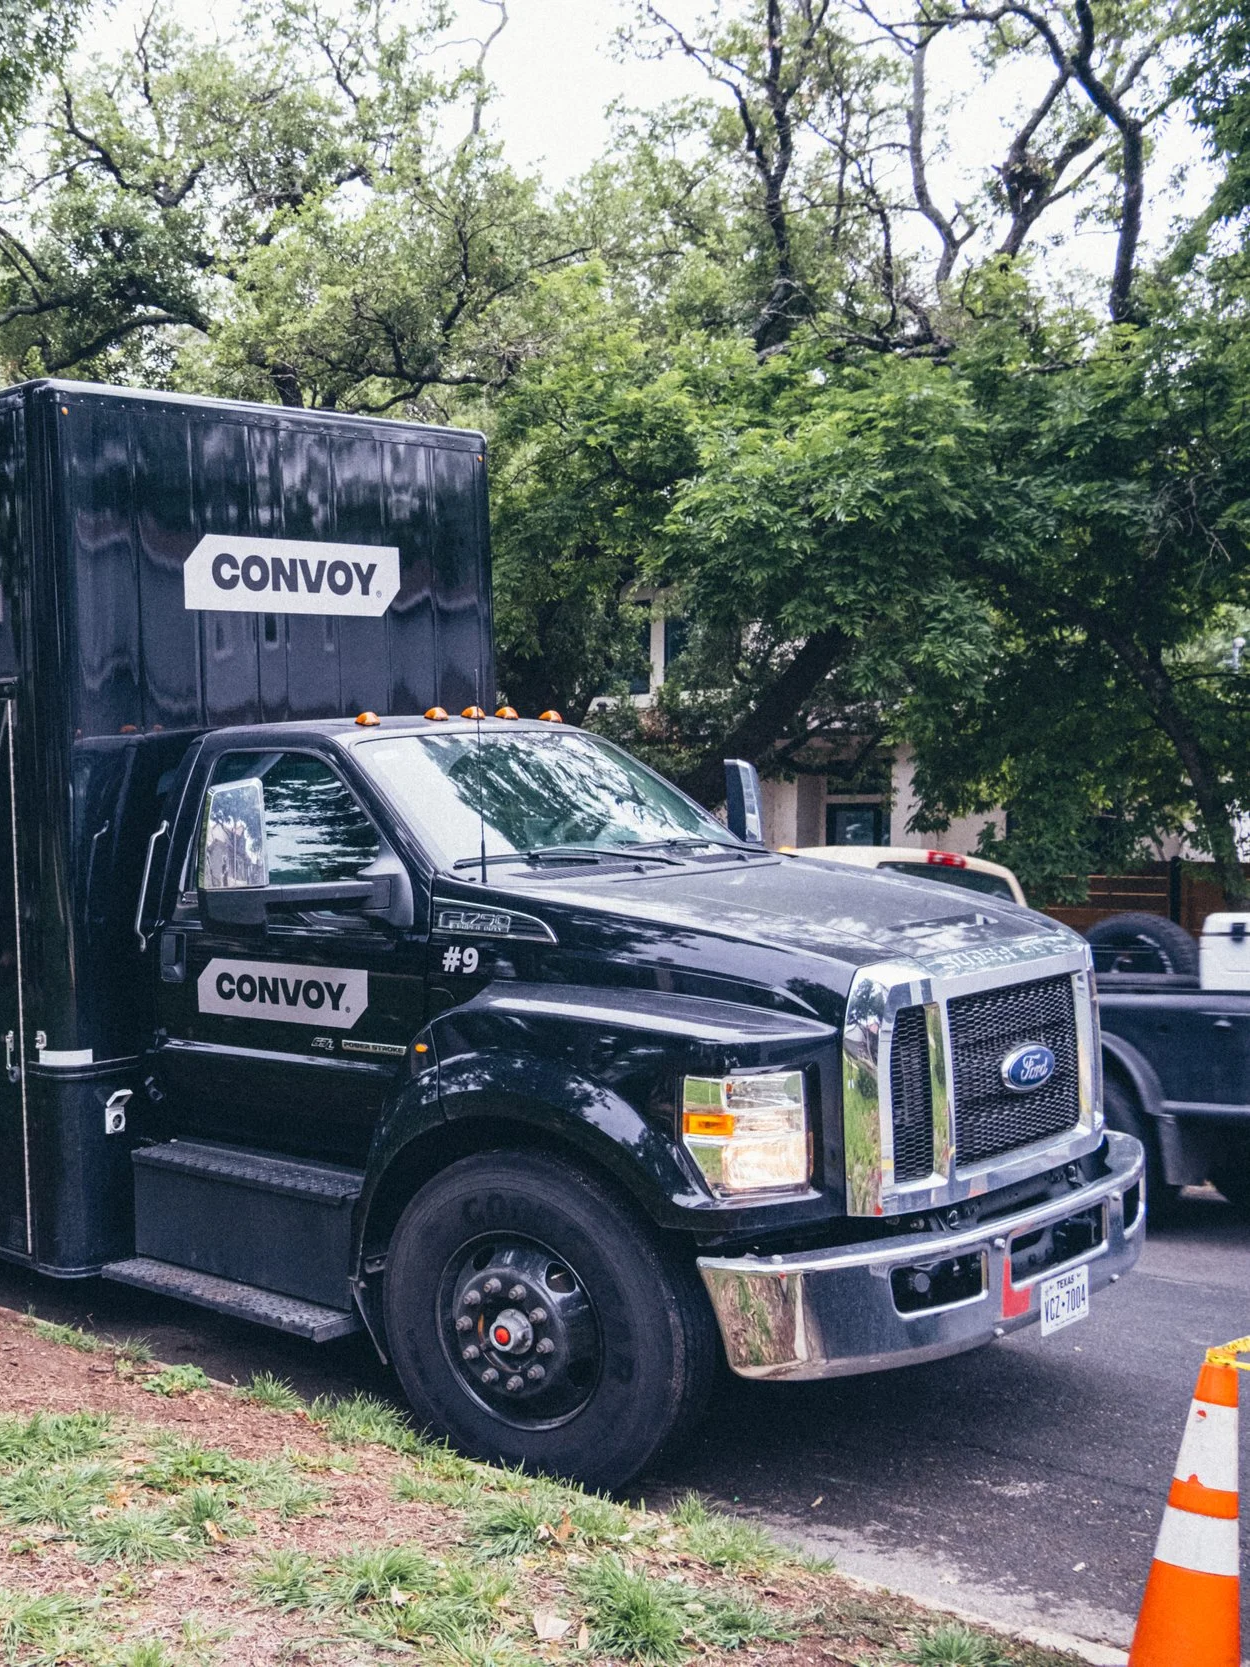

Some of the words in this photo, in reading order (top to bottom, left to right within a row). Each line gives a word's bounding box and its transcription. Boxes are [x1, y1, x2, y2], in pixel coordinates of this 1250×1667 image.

[442, 946, 479, 974] #9
[372, 1045, 404, 1054] STROKE
[1020, 1053, 1049, 1081] Ford
[1057, 1274, 1075, 1290] TEXAS
